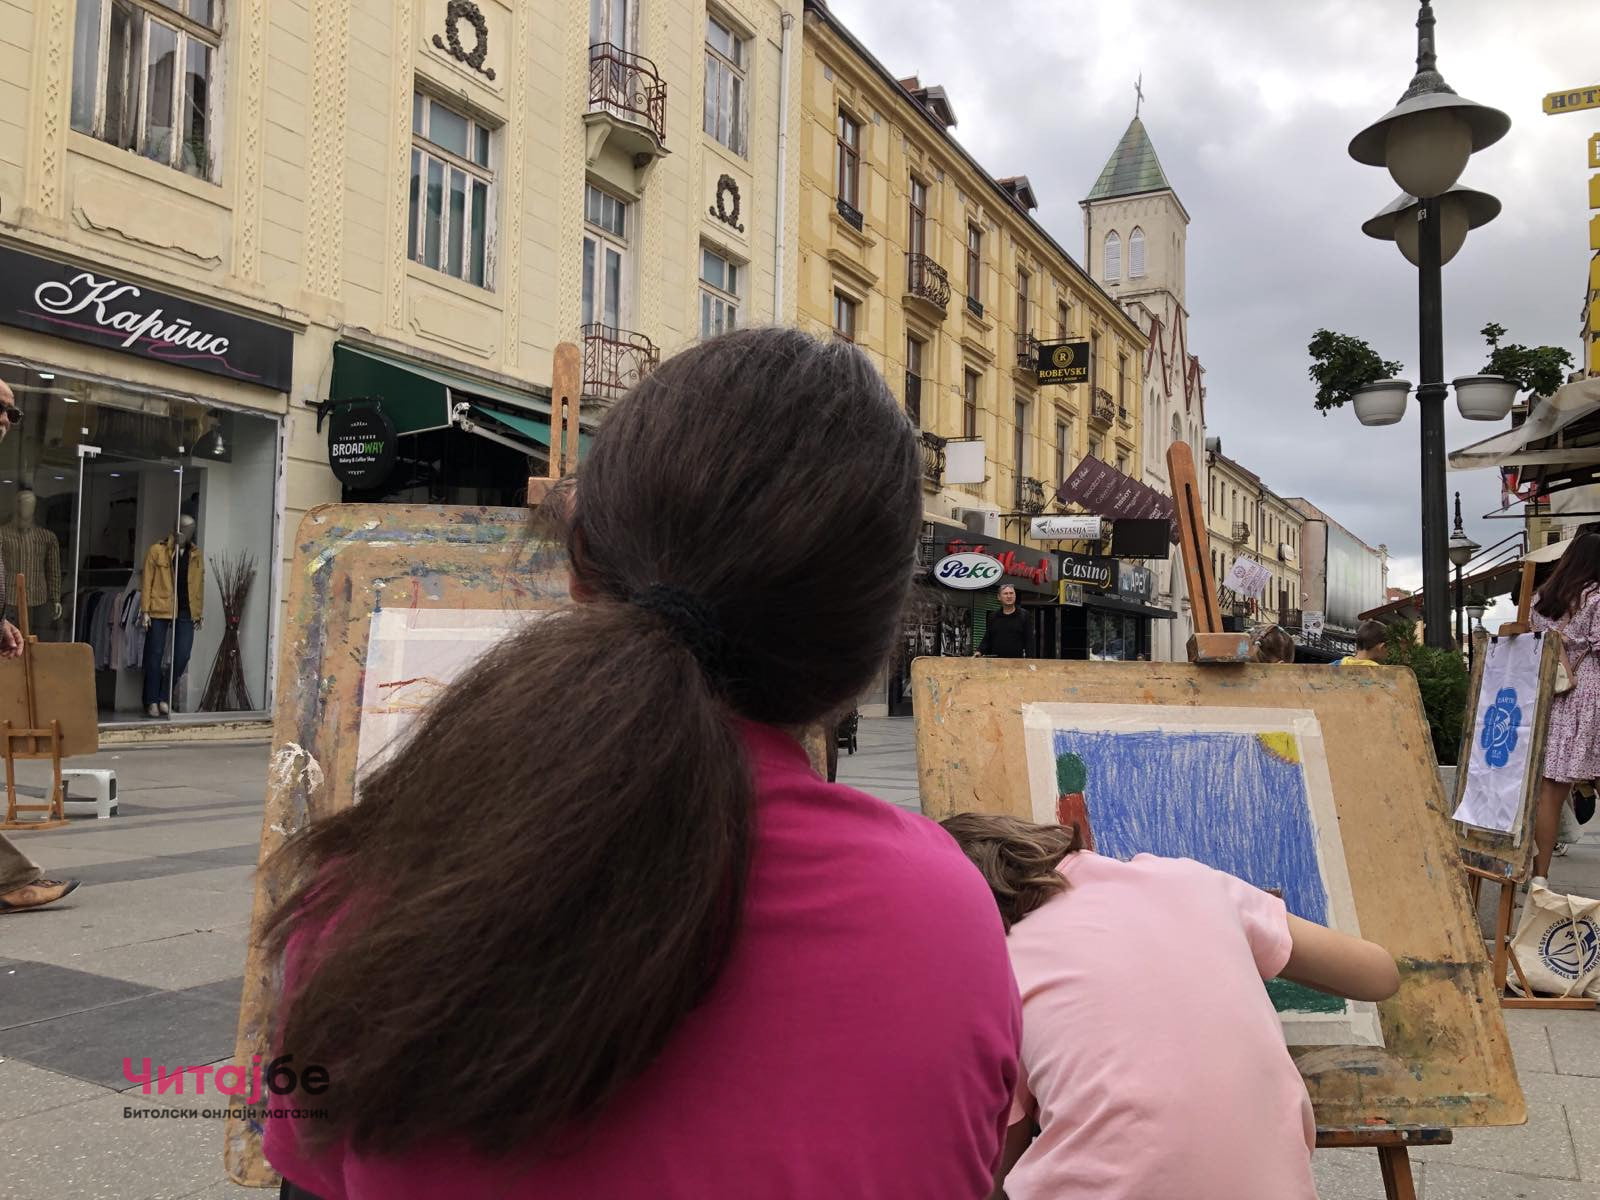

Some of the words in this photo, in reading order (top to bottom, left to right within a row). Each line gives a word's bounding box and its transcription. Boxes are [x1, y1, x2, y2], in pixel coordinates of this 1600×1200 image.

[1551, 89, 1600, 109] HOT
[1039, 367, 1087, 378] ROBEVSKI
[332, 441, 385, 457] BROADWAY
[1114, 489, 1132, 510] TISSOT
[940, 560, 1001, 578] Peko
[1063, 557, 1108, 581] Casino
[1551, 966, 1571, 979] SMALL
